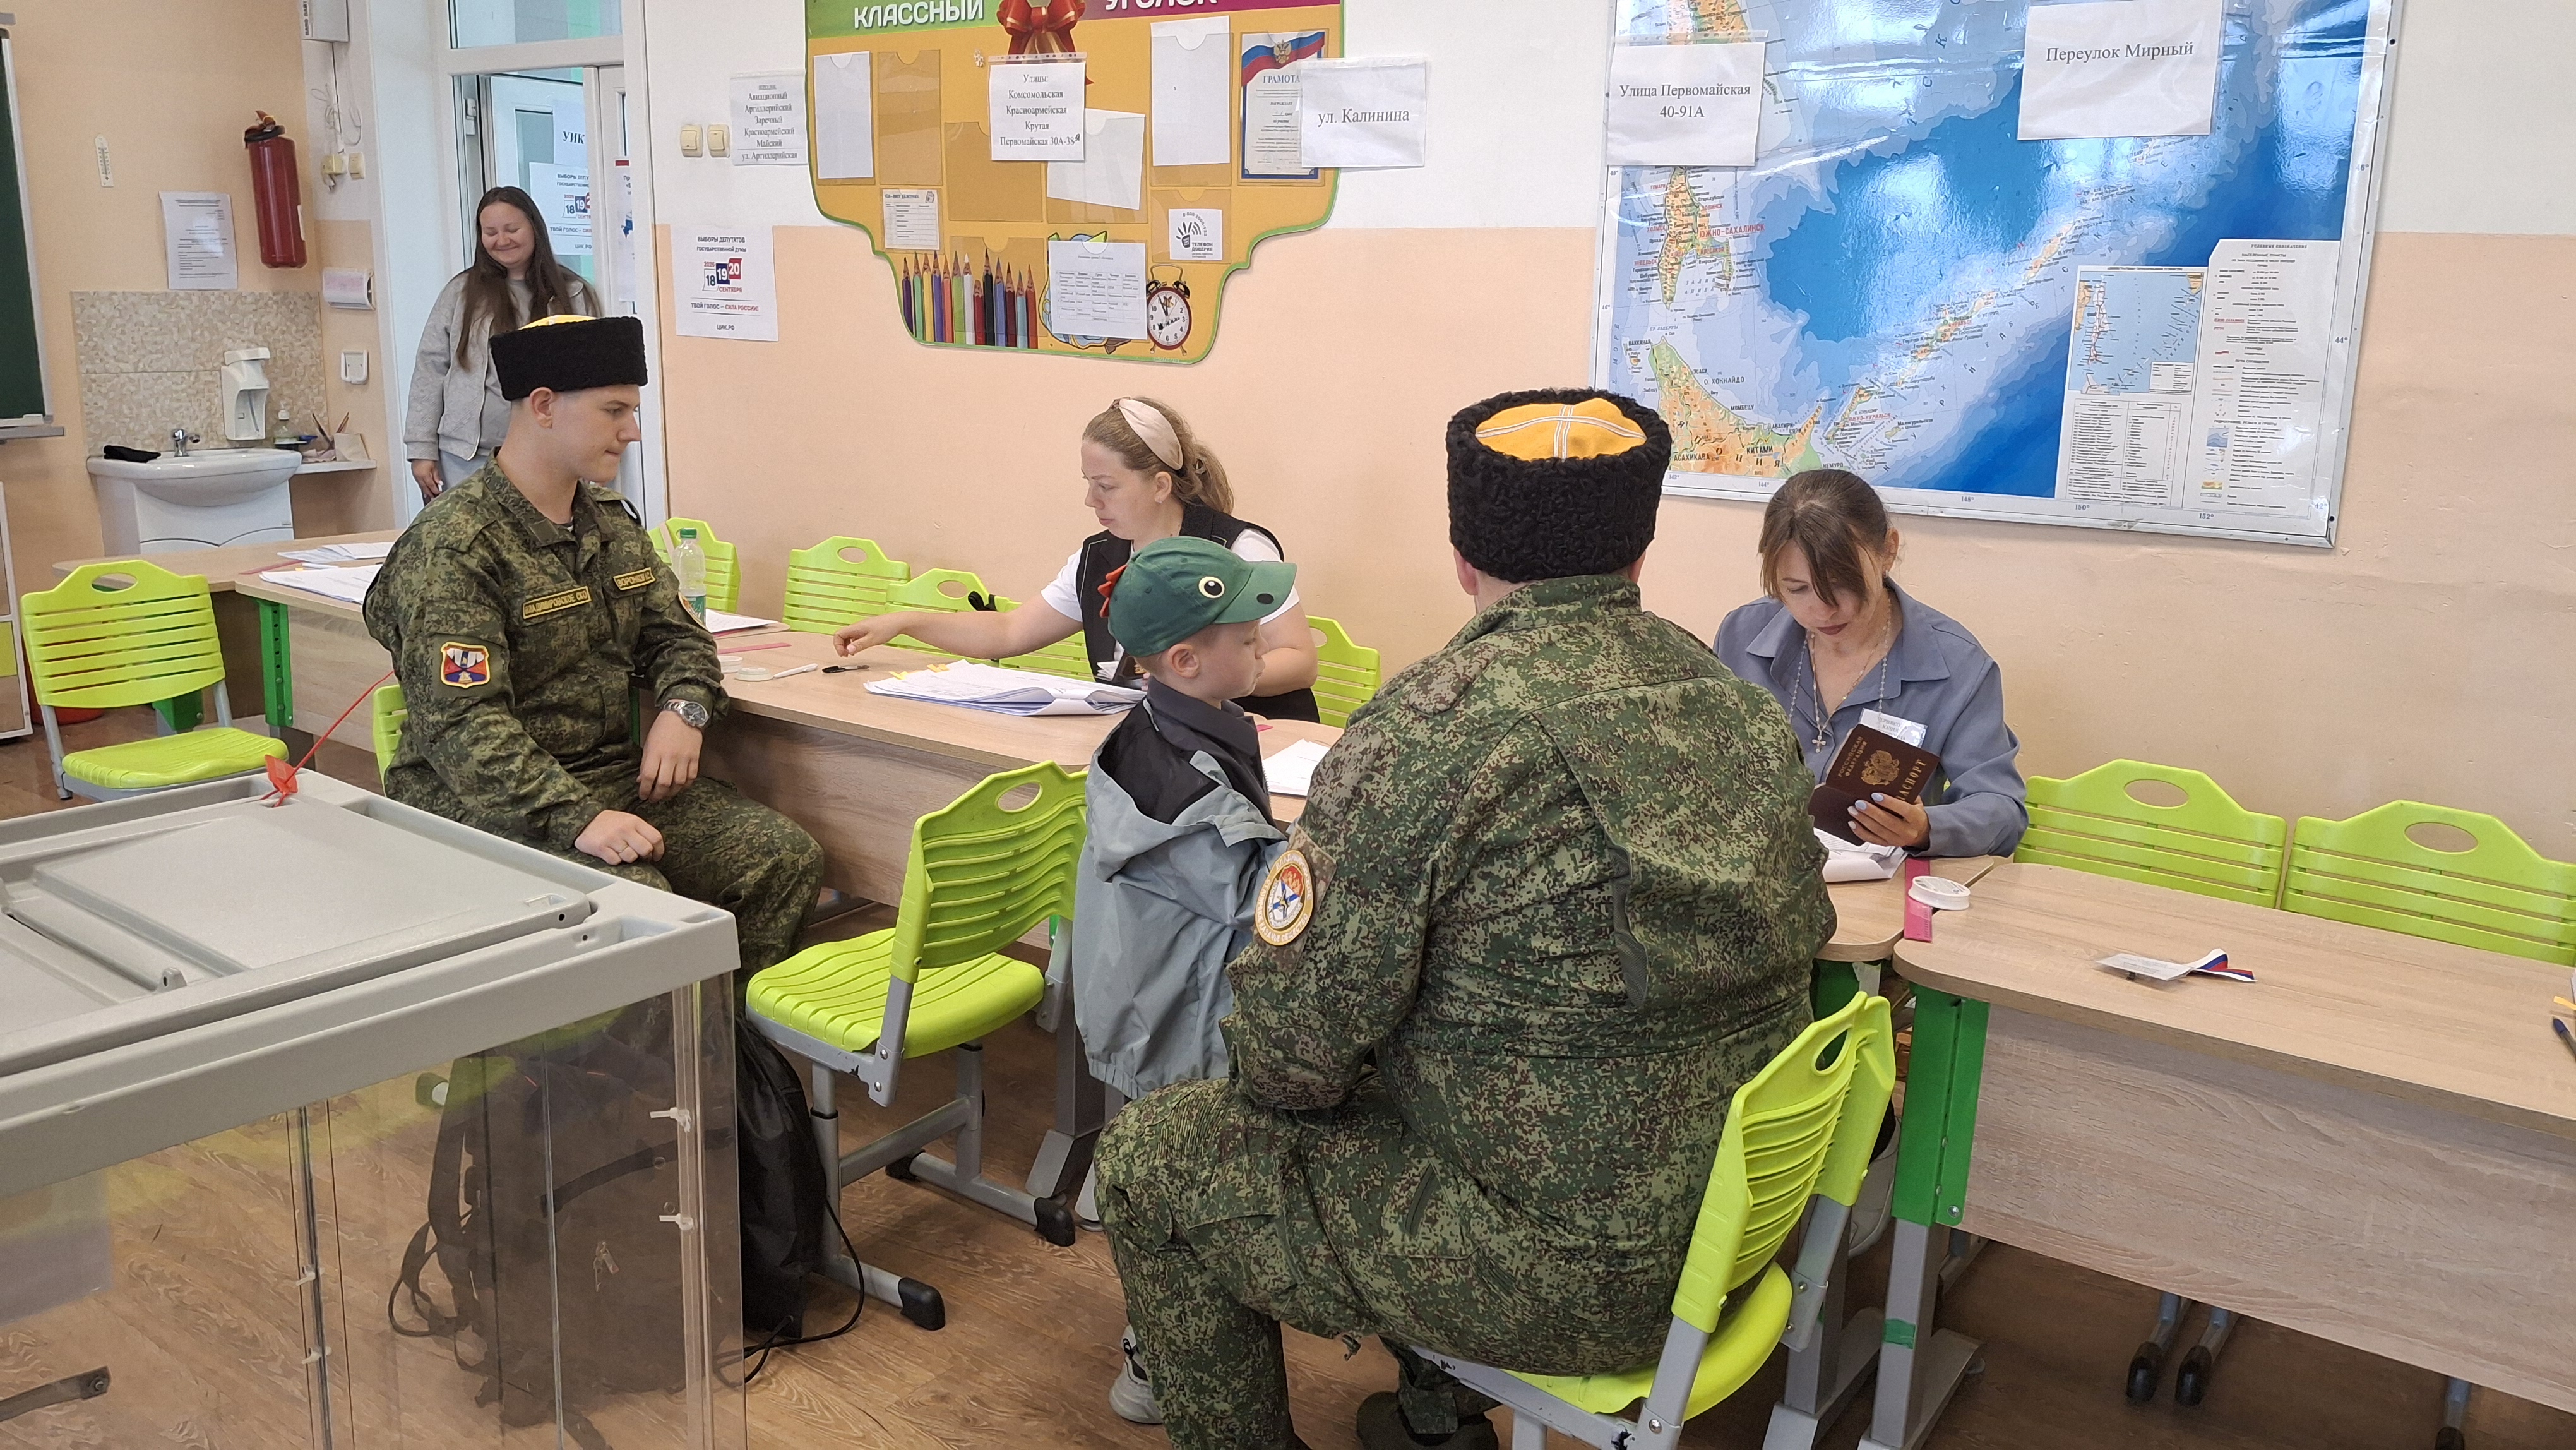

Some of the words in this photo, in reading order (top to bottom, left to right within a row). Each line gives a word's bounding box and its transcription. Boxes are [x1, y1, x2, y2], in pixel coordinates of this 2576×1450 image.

[2046, 47, 2120, 64] Переулок
[2125, 41, 2194, 60] Мирный
[1023, 74, 1049, 83] Улицы:
[1263, 75, 1301, 84] ГРАМОТА
[748, 92, 787, 100] Авиационный
[1008, 90, 1063, 99] Комсомольская
[1619, 85, 1657, 97] Улица
[1661, 84, 1751, 99] Первомайская
[745, 104, 792, 114] Артиллерийский
[1006, 105, 1067, 116] Красноармейская
[1660, 106, 1705, 117] 40-91А
[754, 116, 783, 126] Заречный
[1318, 113, 1337, 128] ул.
[1342, 109, 1410, 123] Калинина
[1025, 121, 1049, 132] Крутая
[563, 131, 585, 145] УИК
[744, 128, 794, 138] Красноармейский
[757, 139, 782, 147] Майский
[1000, 137, 1048, 147] Первомайская
[751, 152, 797, 162] Артиллерийская
[565, 205, 575, 214] 18
[576, 201, 585, 210] 19
[1699, 223, 1765, 239] ЮЖНО-САХАЛИНСК
[717, 268, 727, 280] 19
[729, 263, 740, 275] 20
[706, 275, 716, 286] 18
[1712, 376, 1744, 385] ХОККАЙДО
[1746, 445, 1774, 455] КИТАМИ
[1674, 453, 1710, 462] АСАХИКАВА
